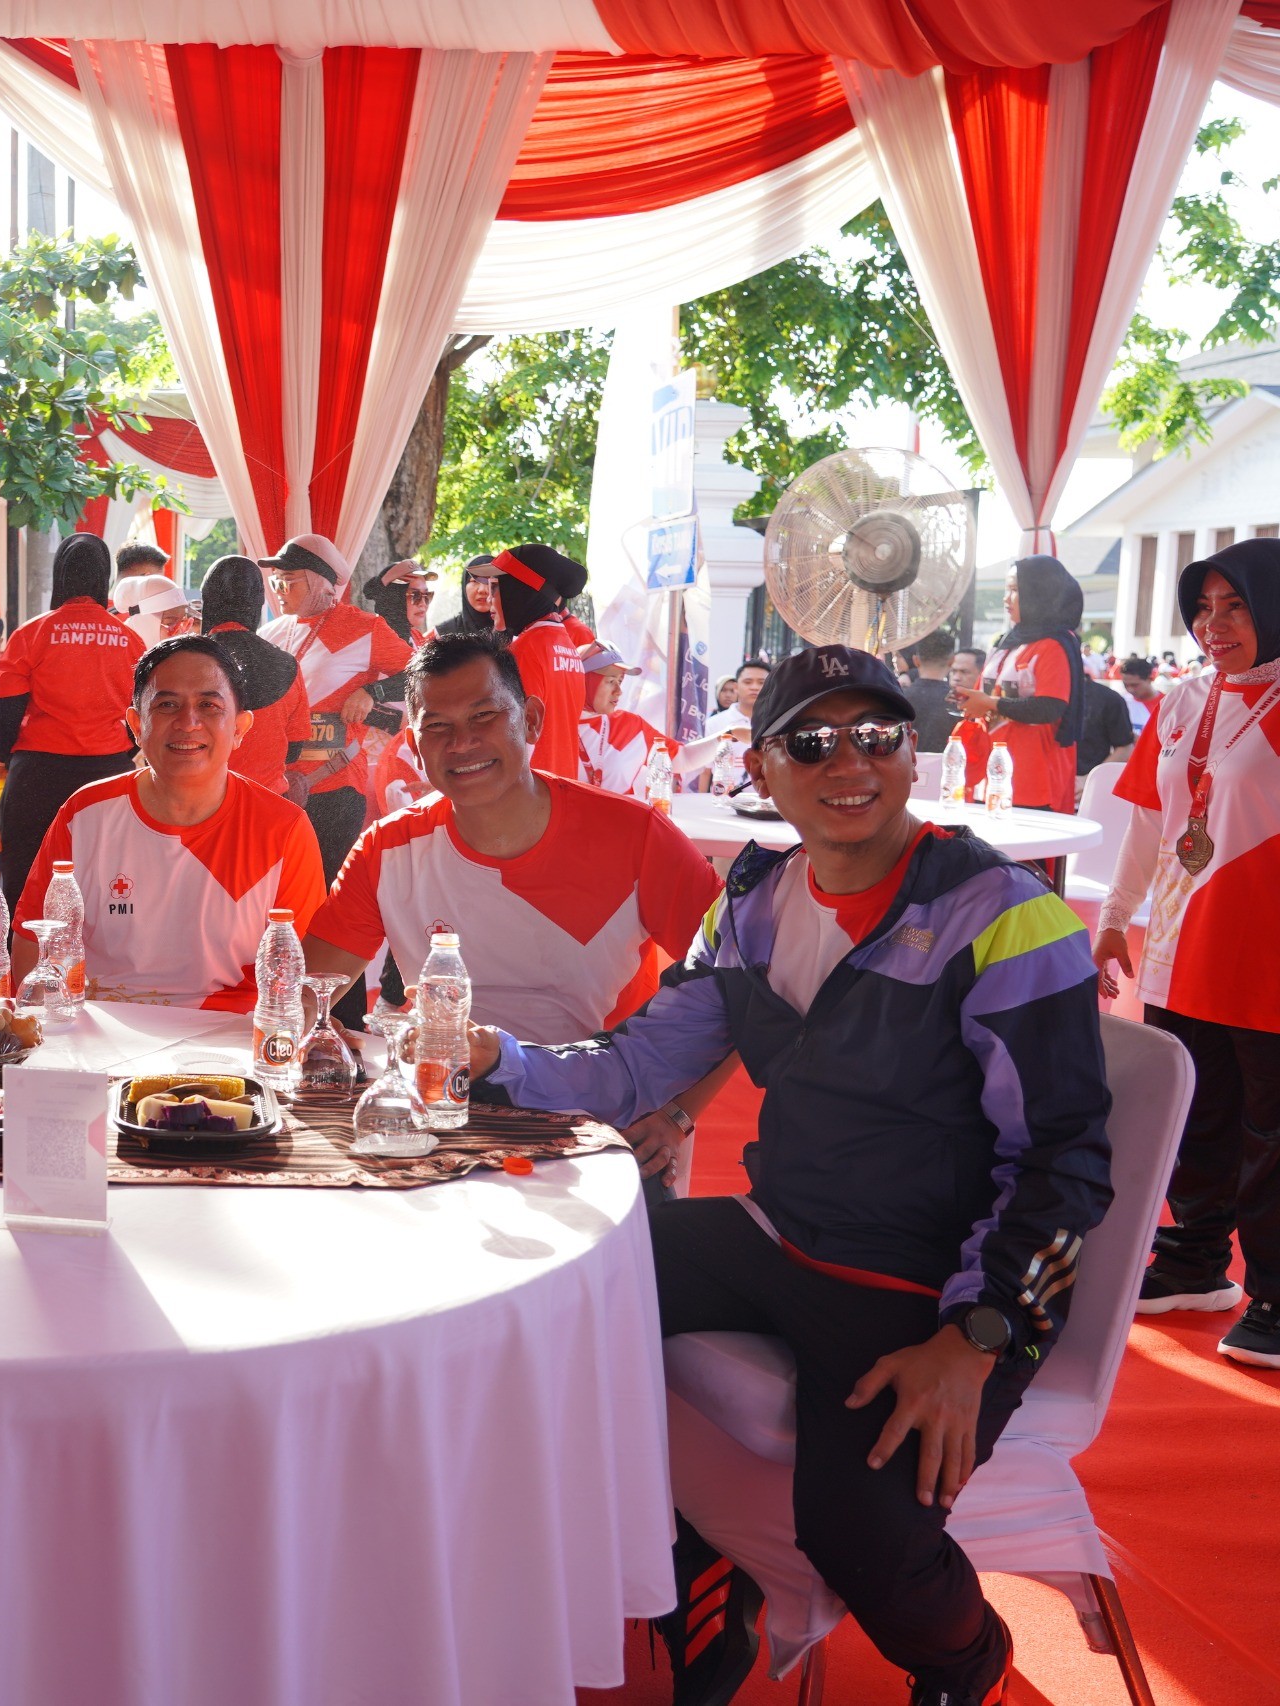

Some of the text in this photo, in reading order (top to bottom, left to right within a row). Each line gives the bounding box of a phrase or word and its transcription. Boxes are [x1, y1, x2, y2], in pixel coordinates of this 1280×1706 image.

[53, 622, 123, 634] KAWAN LARI
[50, 632, 129, 648] LAMPUNG
[818, 653, 850, 678] LA
[1200, 686, 1220, 740] ANNIVERSARY
[1225, 715, 1254, 750] HUMANITY
[109, 903, 134, 915] PMI
[269, 1039, 293, 1058] Cleo
[455, 1074, 469, 1093] Cle
